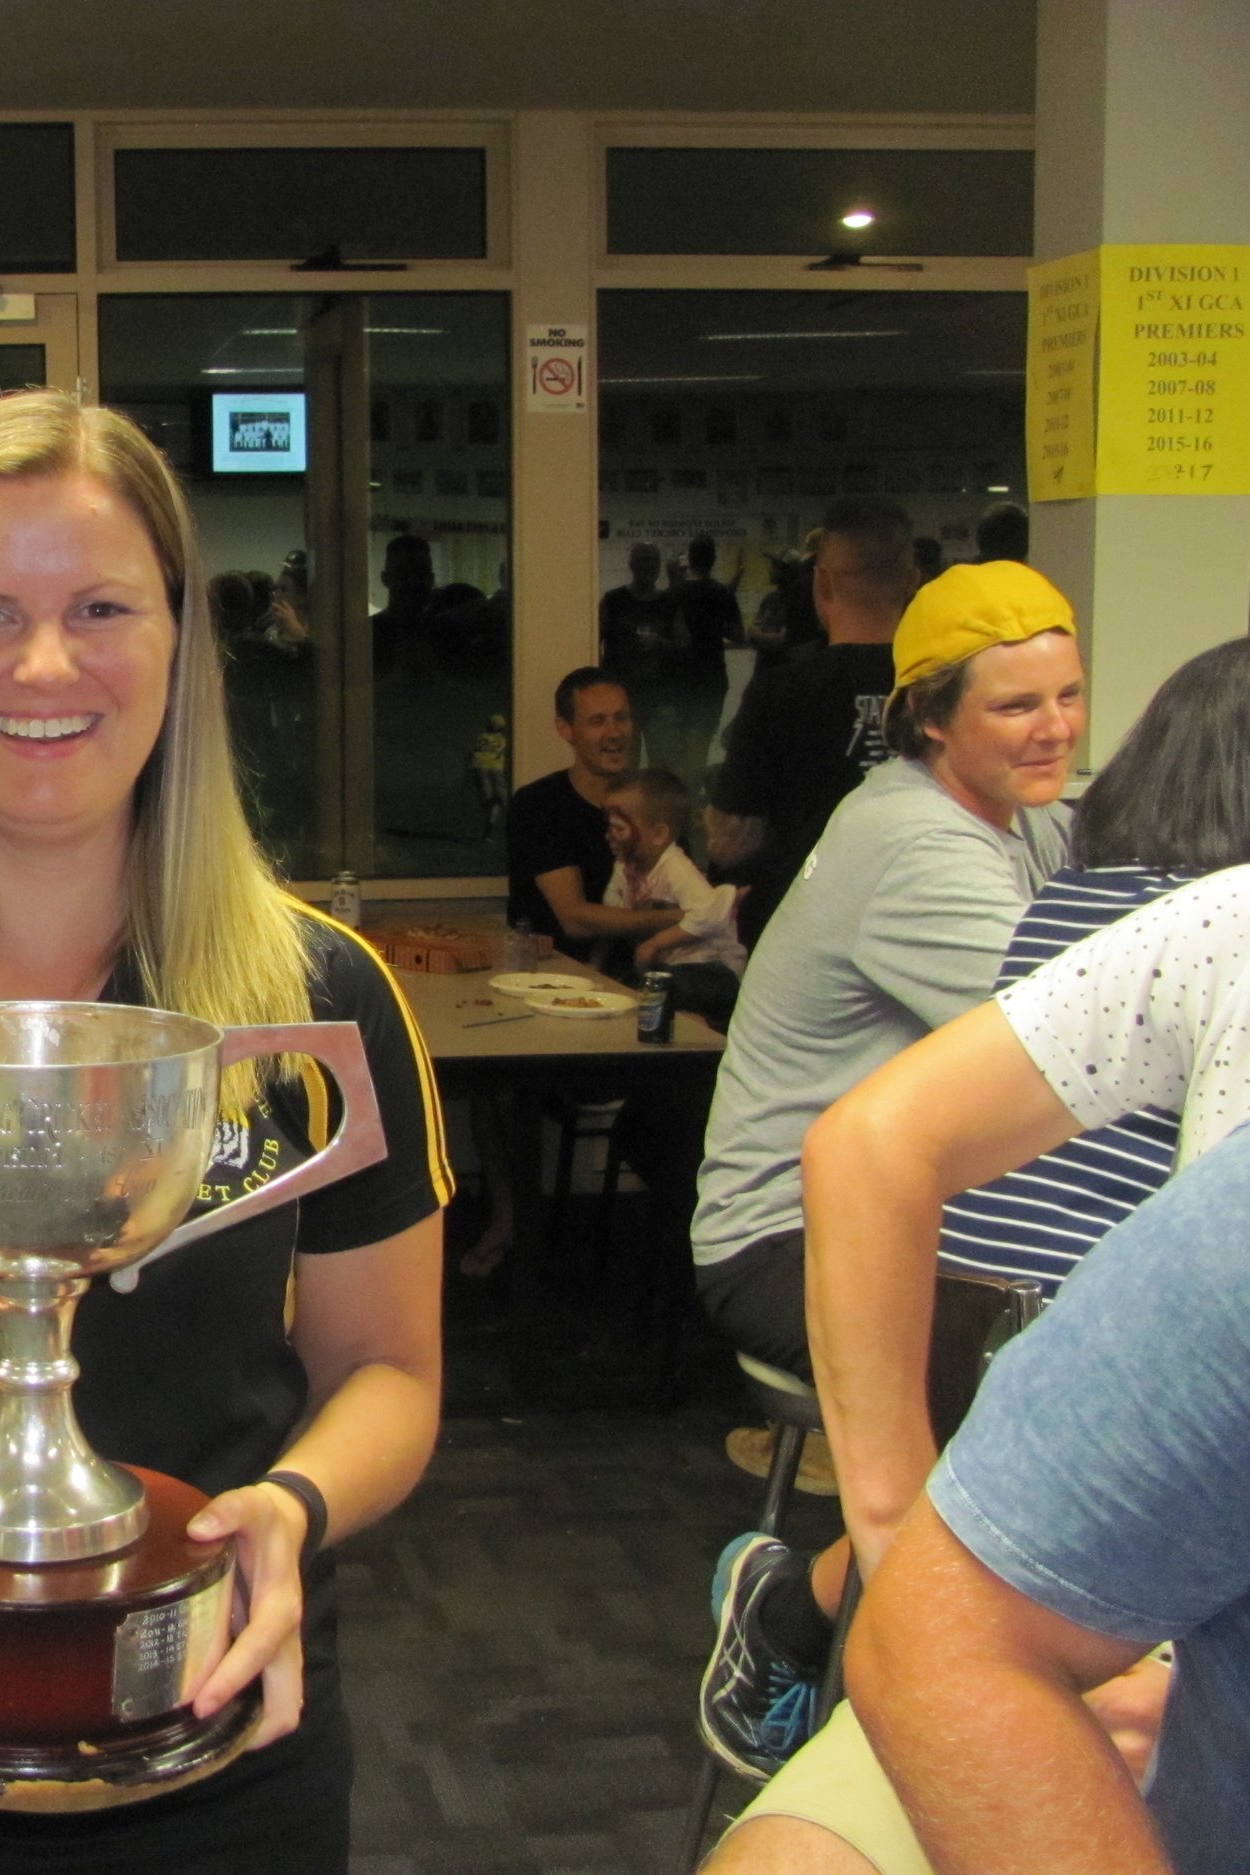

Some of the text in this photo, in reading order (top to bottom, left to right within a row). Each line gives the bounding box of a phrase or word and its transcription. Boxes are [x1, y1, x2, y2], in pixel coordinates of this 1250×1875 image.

[1129, 265, 1227, 282] DIVISION
[1170, 294, 1193, 311] XI
[1199, 294, 1243, 311] GCA
[548, 328, 566, 337] NO
[1133, 323, 1245, 339] PREMIERS
[530, 338, 585, 347] SMOKING
[1148, 352, 1217, 367] 2003-04
[1148, 380, 1216, 395] 2007-08
[1148, 407, 1214, 423] 2011-12
[1147, 436, 1213, 451] 2015-16
[242, 1138, 280, 1193] CLUB
